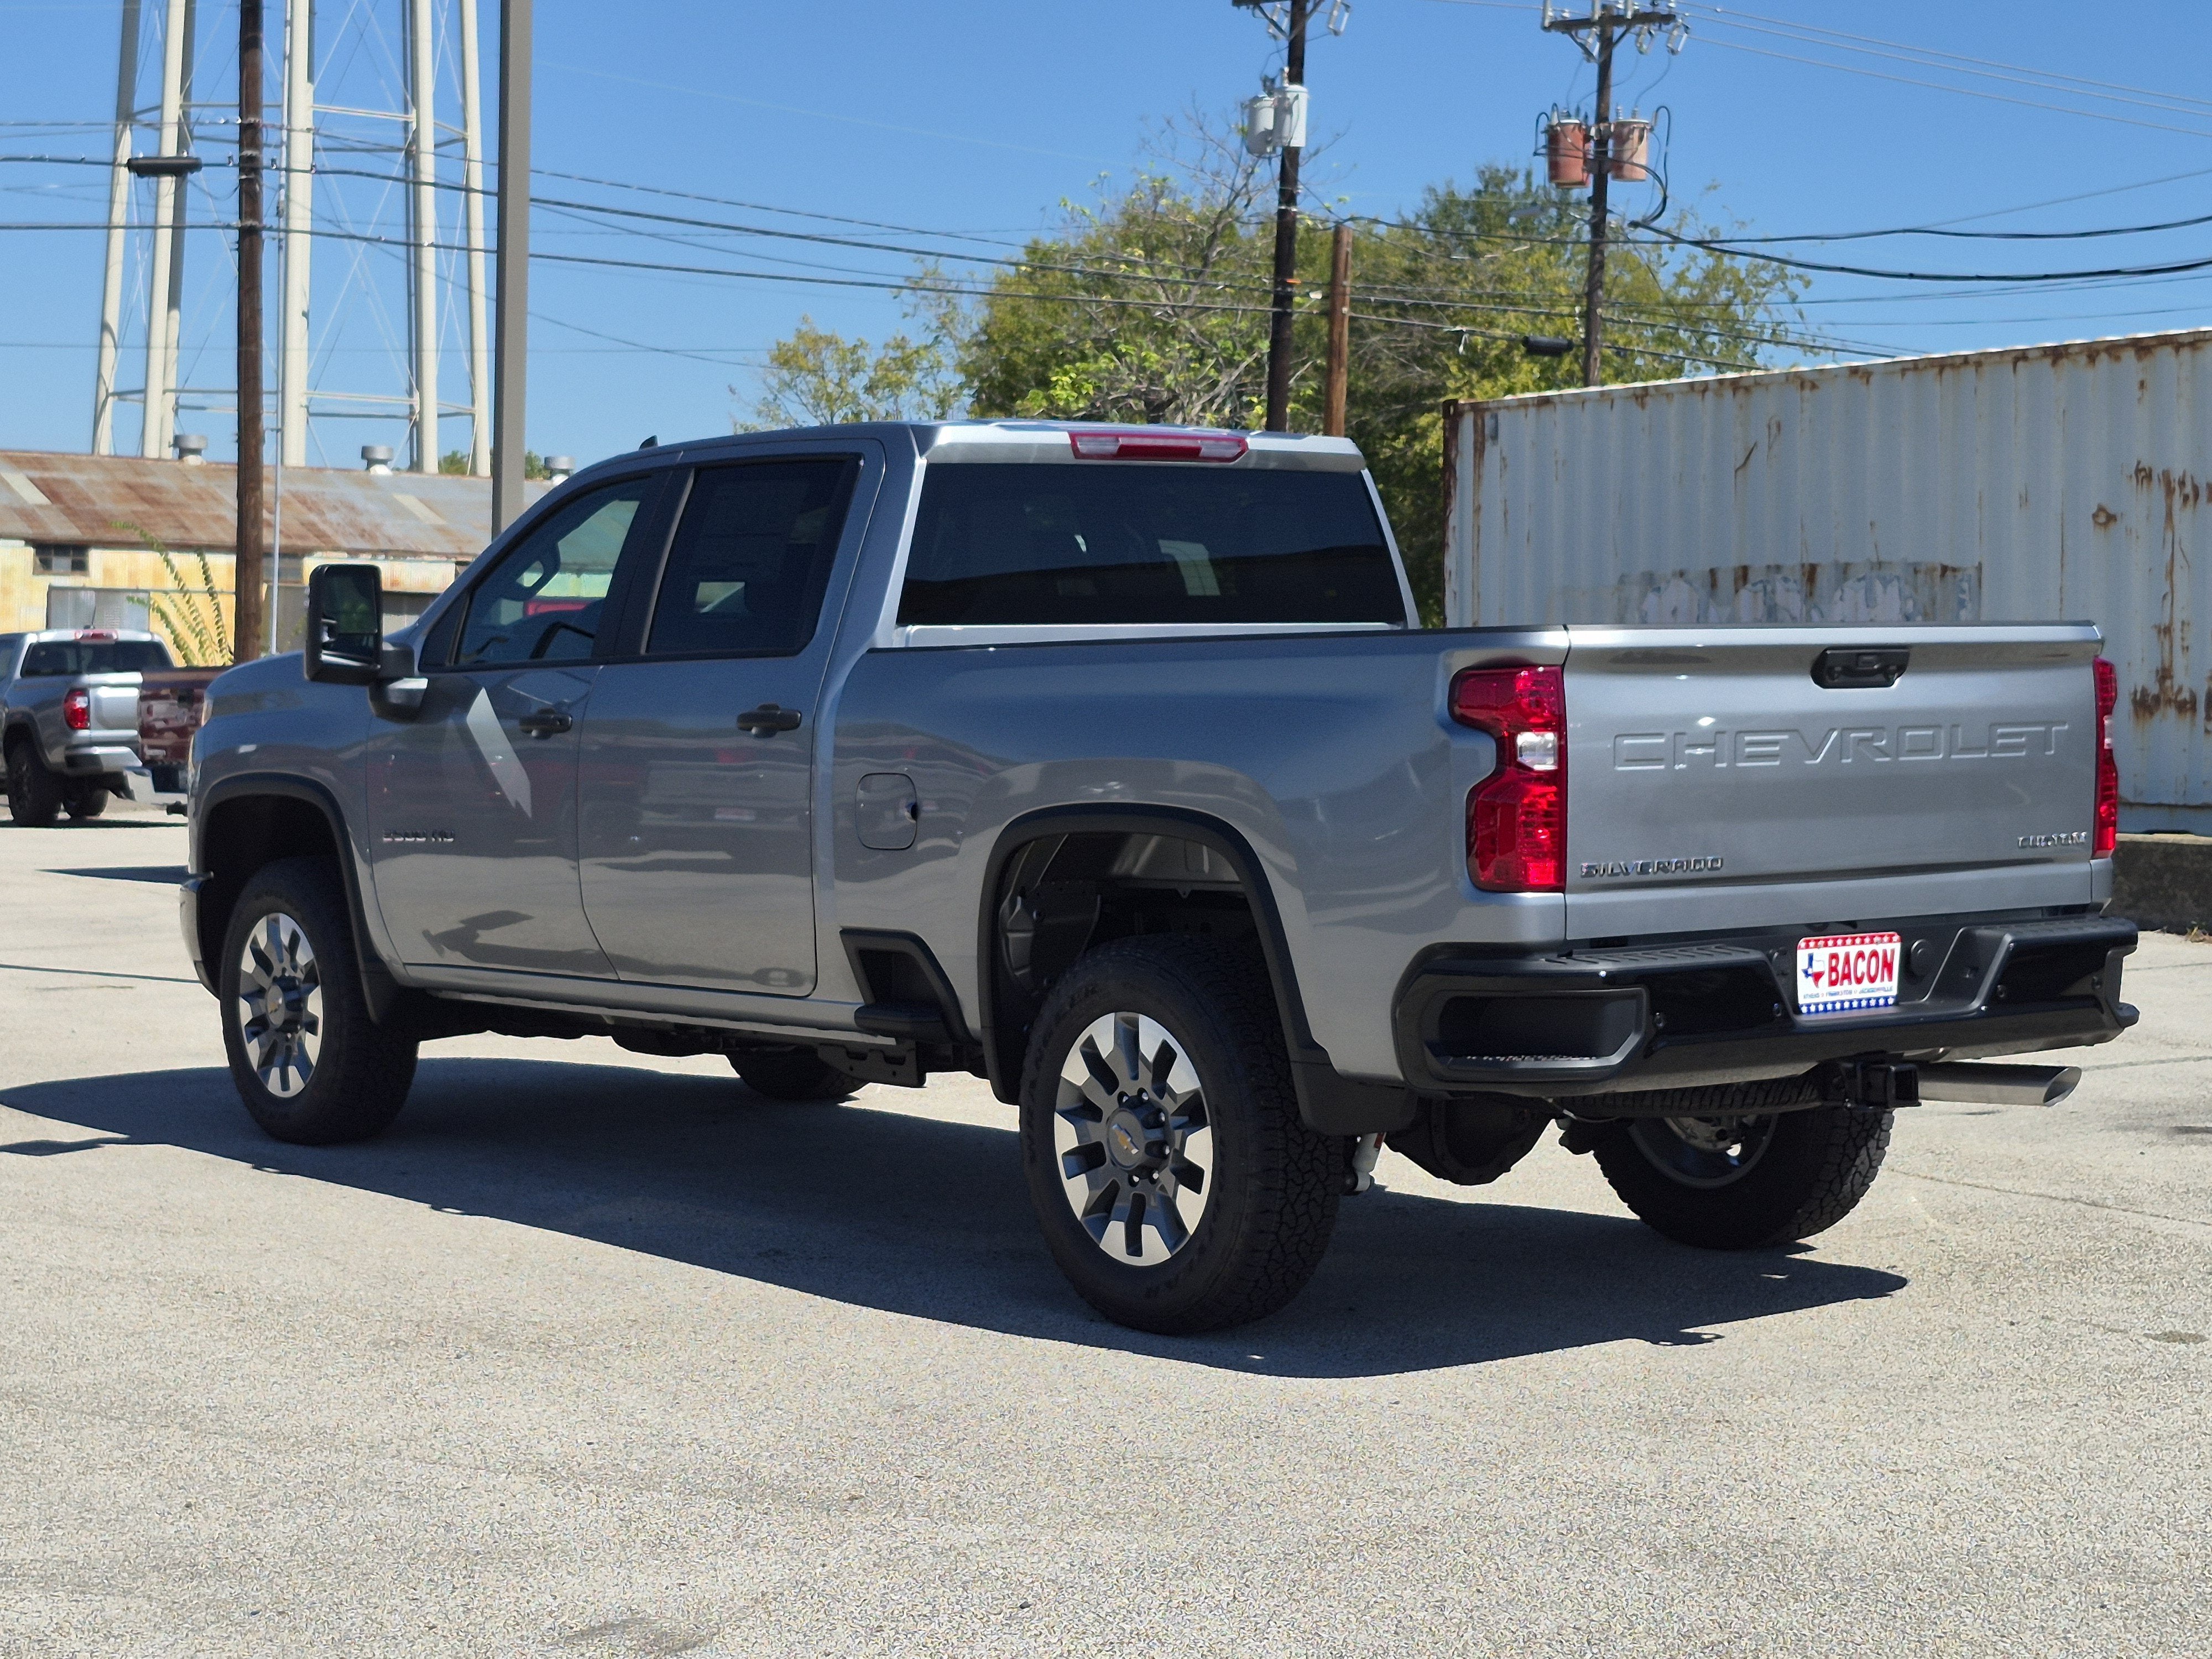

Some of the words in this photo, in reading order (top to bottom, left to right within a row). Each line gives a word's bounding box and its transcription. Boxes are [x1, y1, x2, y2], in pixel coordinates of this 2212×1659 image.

[1614, 722, 2069, 770] CHEVROLET
[1580, 855, 1724, 878] SILVERADO
[1828, 948, 1895, 987] BACON
